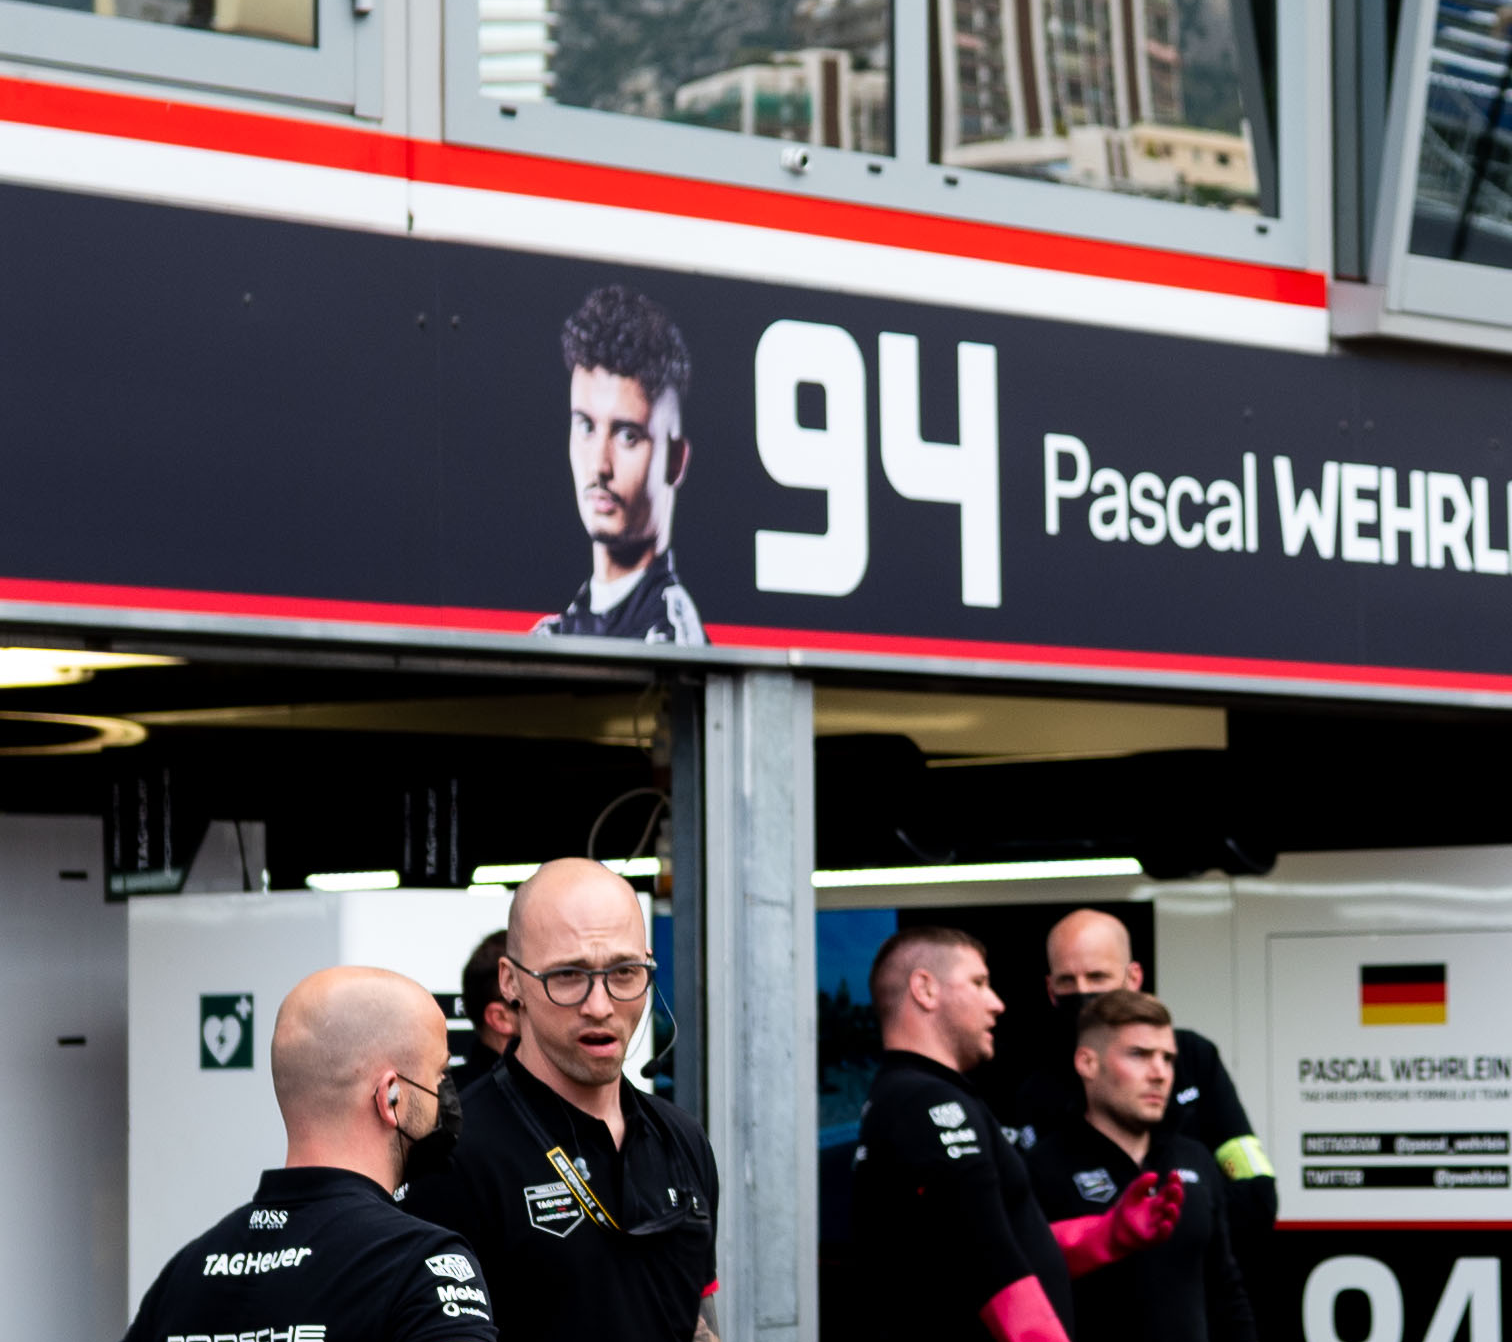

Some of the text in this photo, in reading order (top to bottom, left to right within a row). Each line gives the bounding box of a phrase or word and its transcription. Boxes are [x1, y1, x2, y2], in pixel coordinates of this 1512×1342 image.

[754, 318, 1001, 608] 94
[1043, 433, 1258, 553] Pascal
[1298, 1056, 1512, 1084] PASCAL WEHRLEIN
